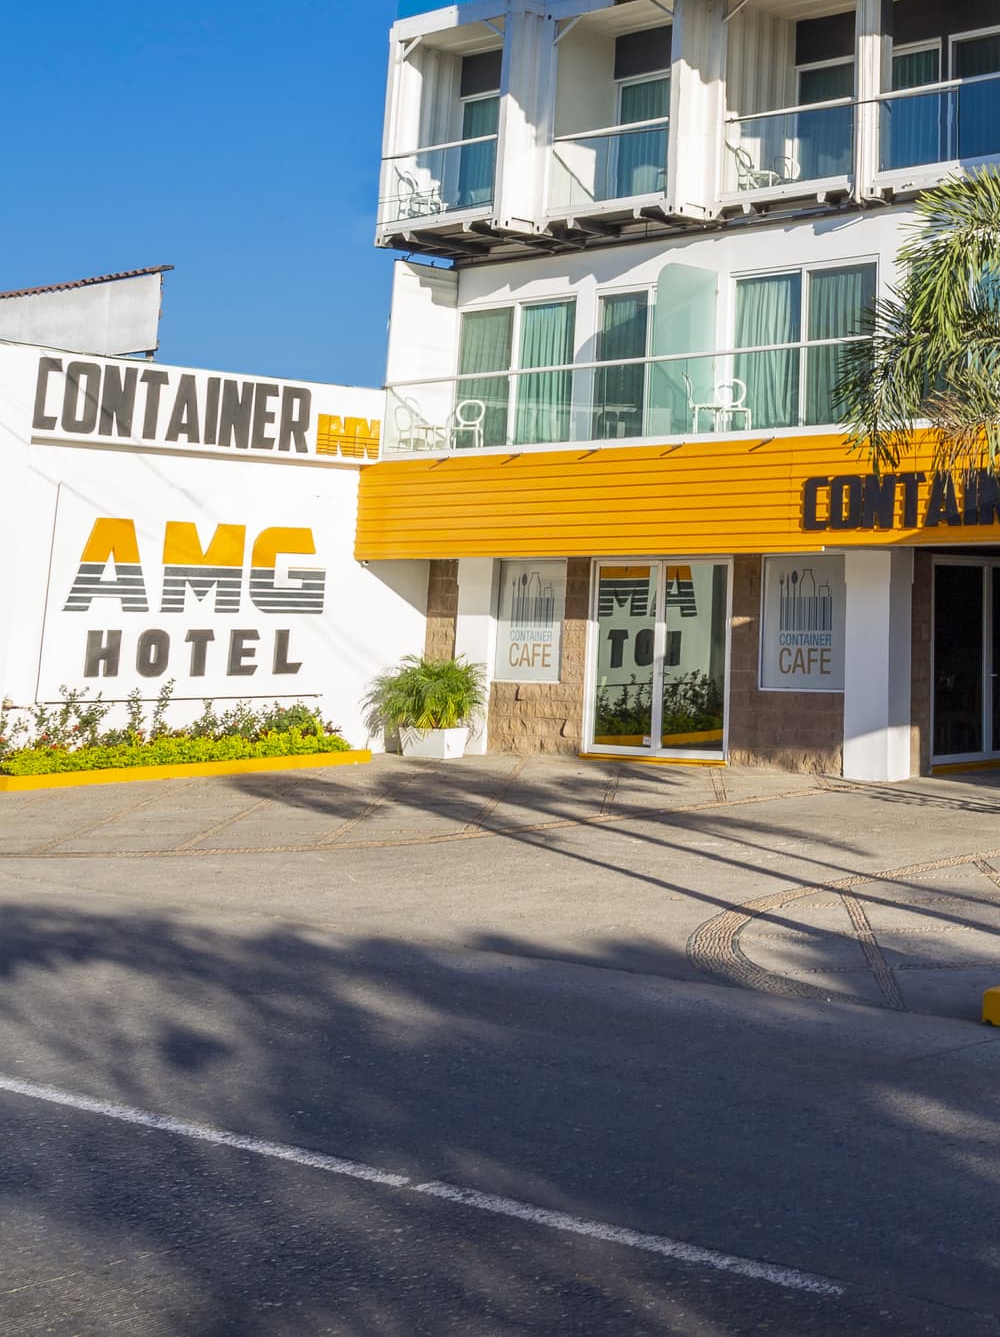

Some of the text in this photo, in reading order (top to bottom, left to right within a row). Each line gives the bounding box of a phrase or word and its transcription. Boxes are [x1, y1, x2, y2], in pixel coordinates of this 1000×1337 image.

[33, 356, 381, 460] CONTAINER INN
[61, 517, 327, 615] AMG
[510, 629, 553, 642] CONTAINER
[778, 632, 833, 647] CONTAINER
[83, 629, 303, 678] HOTEL
[508, 642, 552, 668] CAFE
[778, 647, 833, 675] CAFE
